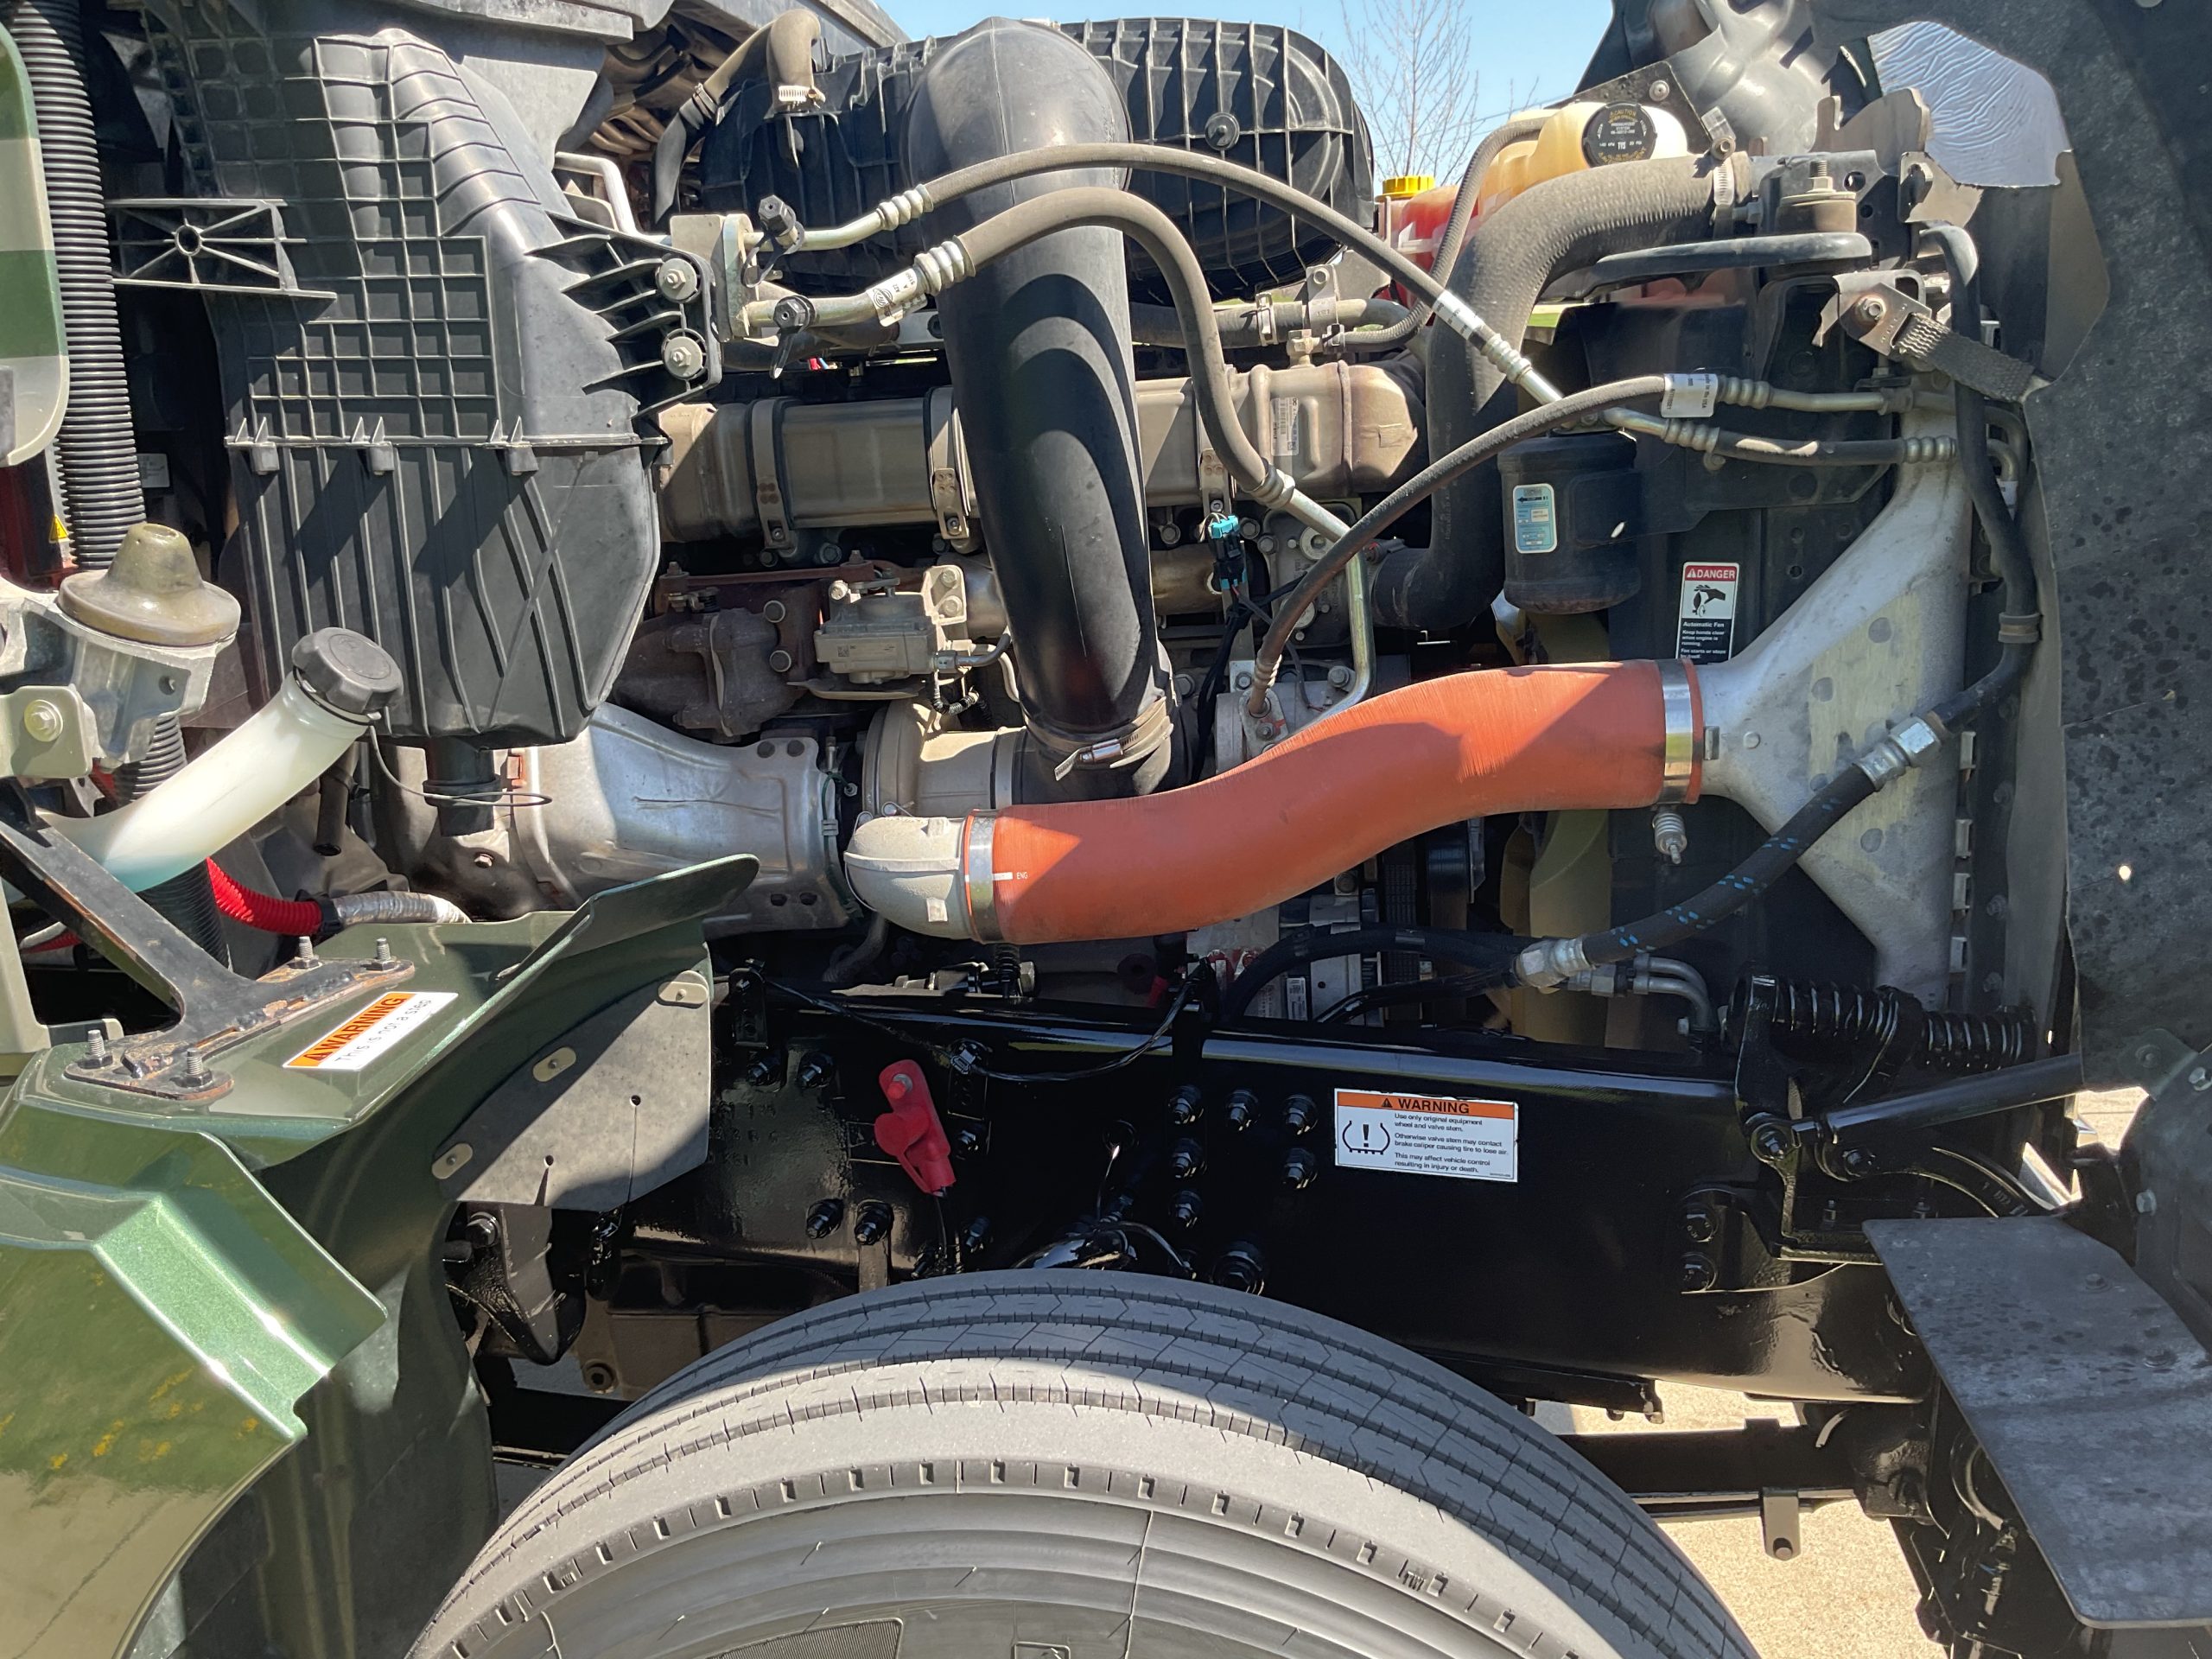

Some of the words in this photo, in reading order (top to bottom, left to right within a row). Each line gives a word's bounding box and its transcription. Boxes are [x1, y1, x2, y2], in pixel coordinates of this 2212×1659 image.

[1697, 569, 1735, 579] DANGER
[315, 998, 408, 1051] WARNING
[335, 1046, 370, 1063] This
[369, 1037, 382, 1046] is
[378, 1022, 399, 1036] not
[405, 1000, 432, 1015] step
[1398, 1098, 1469, 1114] WARNING
[1436, 1144, 1462, 1153] causing
[1395, 1160, 1422, 1169] resulting
